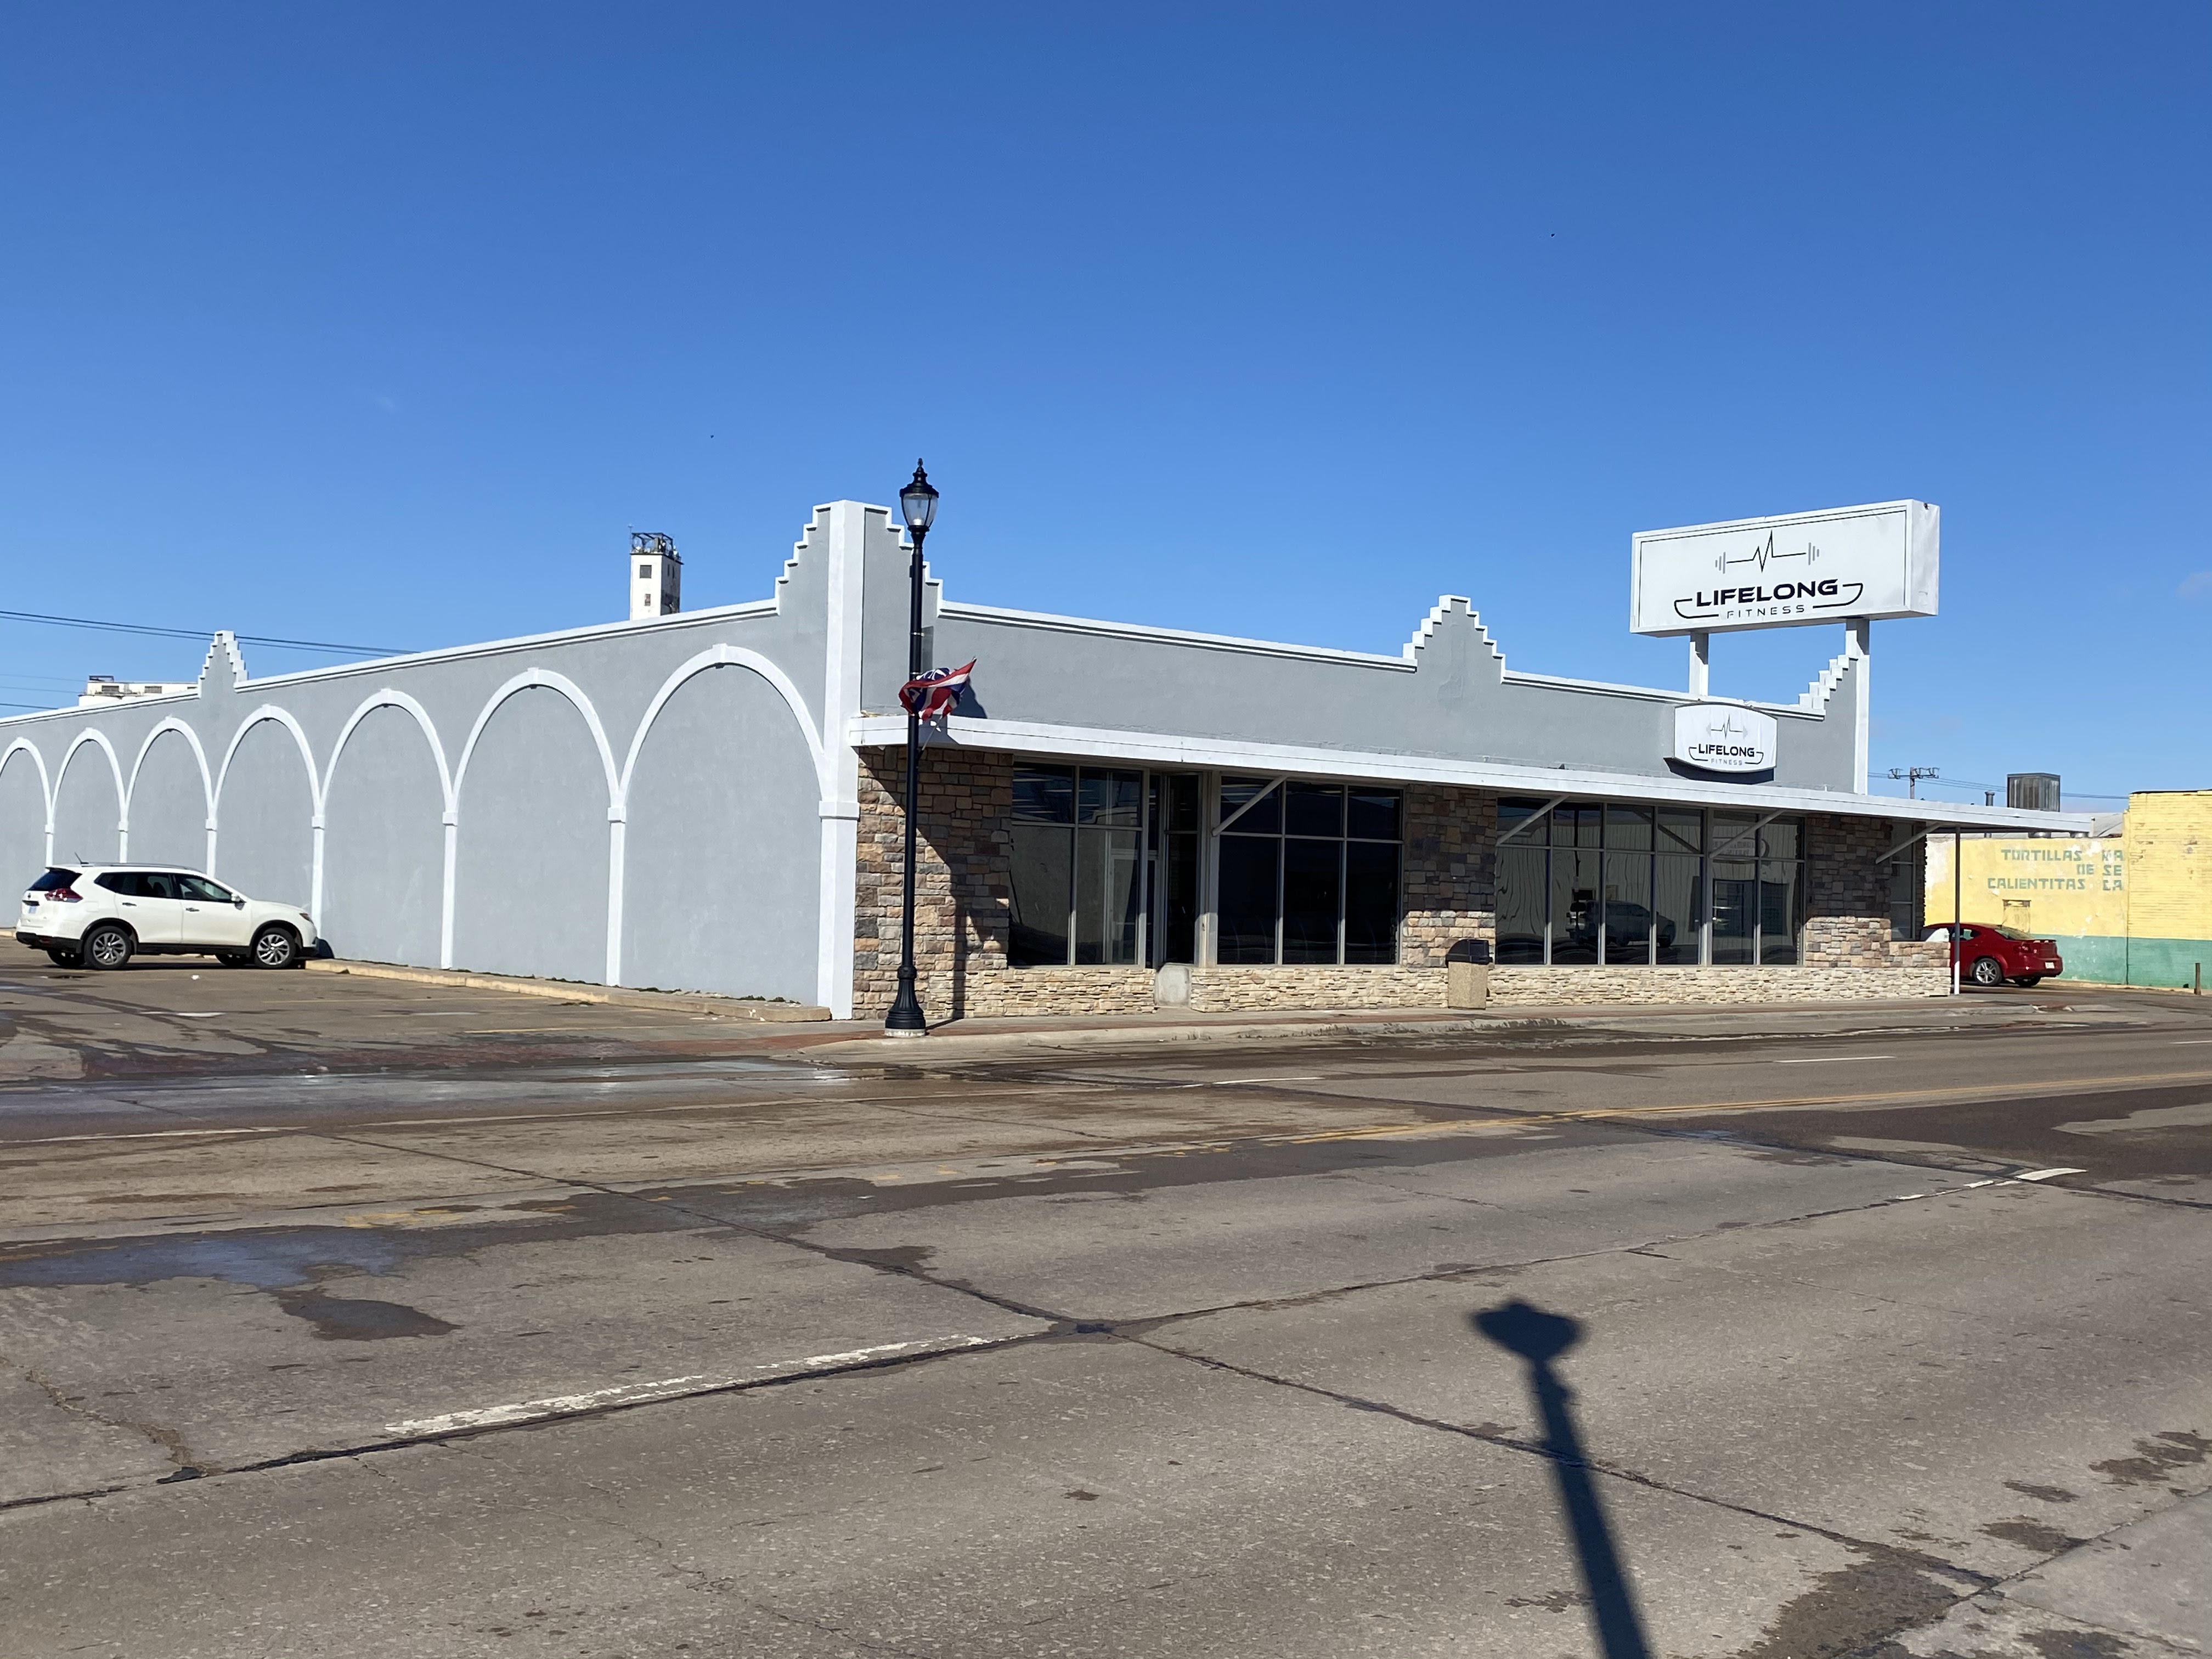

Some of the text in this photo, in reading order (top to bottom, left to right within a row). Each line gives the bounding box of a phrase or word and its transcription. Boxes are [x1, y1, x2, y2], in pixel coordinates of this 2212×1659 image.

[1696, 579, 1838, 607] LIFELONG
[1726, 605, 1805, 619] FITNESS
[1698, 743, 1755, 757] LIFELONG
[1711, 758, 1743, 766] FITNESS
[2001, 849, 2083, 861] TORTILLAS
[2102, 865, 2122, 876] SE
[1987, 878, 2086, 890] CALIENTITAS
